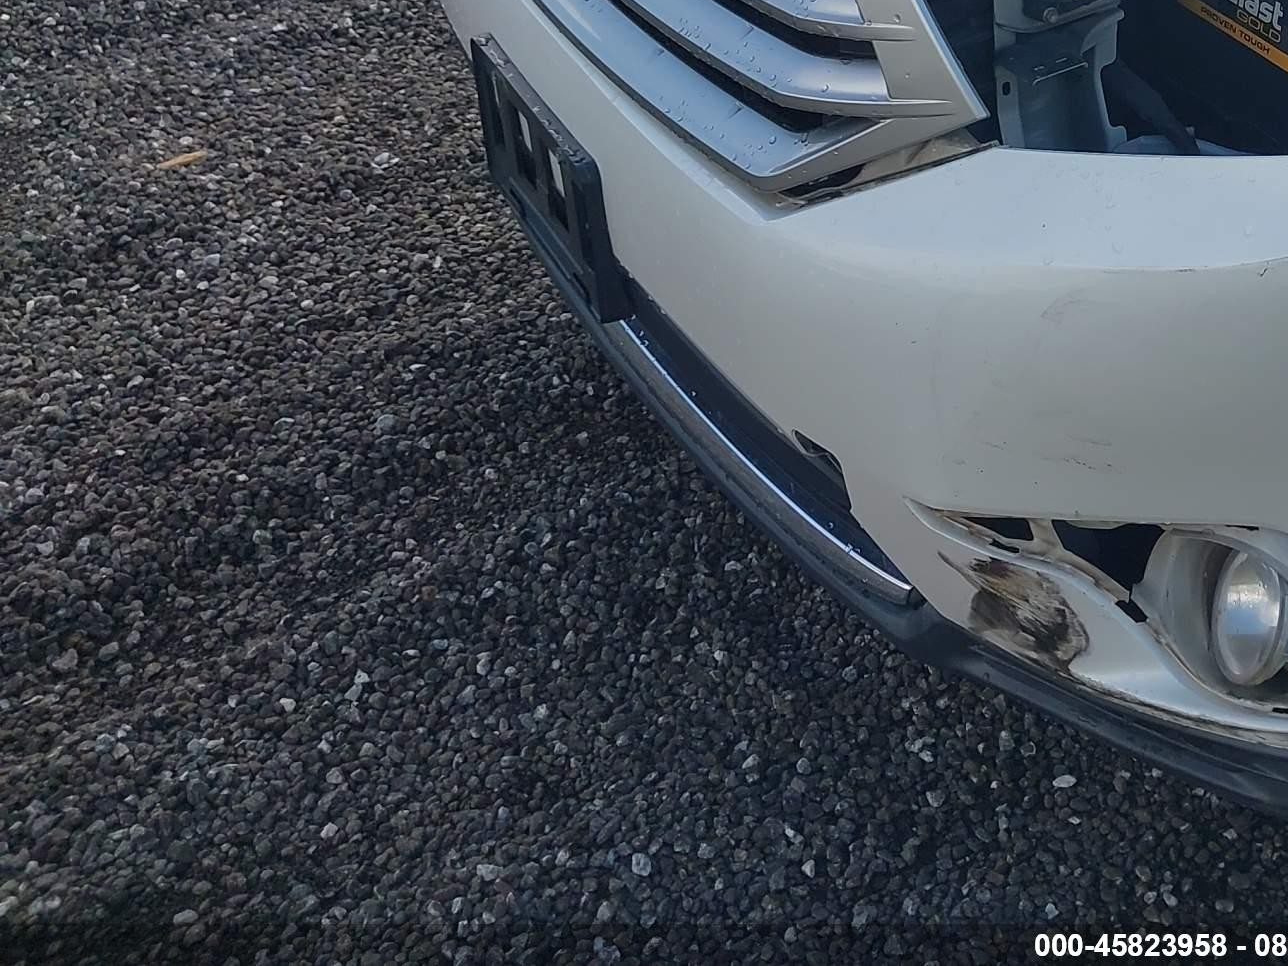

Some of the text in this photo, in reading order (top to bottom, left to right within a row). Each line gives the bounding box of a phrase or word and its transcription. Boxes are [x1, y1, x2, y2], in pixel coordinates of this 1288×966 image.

[1200, 5, 1270, 55] PROVEN TOUGH
[1237, 9, 1281, 43] GOLD
